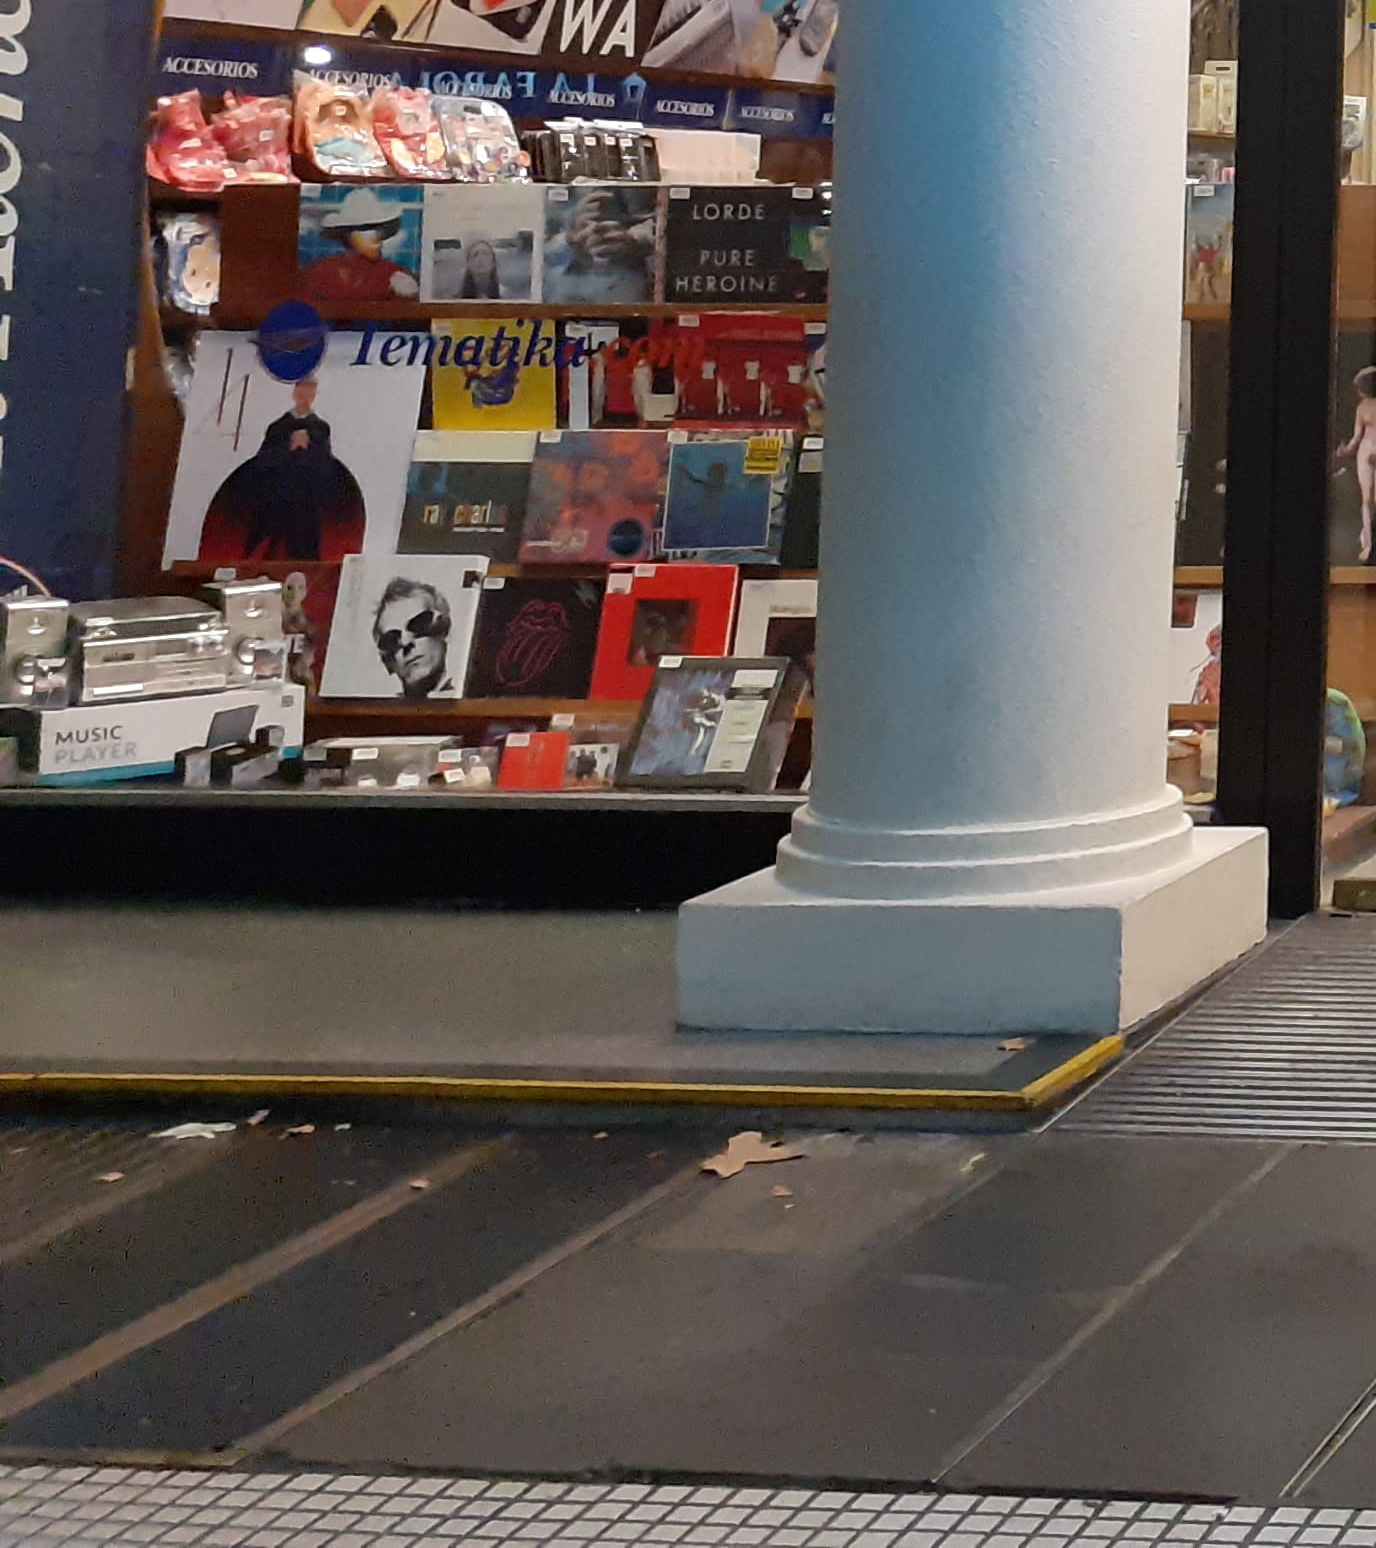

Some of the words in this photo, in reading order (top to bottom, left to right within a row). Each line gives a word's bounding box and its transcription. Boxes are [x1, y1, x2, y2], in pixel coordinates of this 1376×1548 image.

[162, 56, 258, 79] ACCESORIOS
[309, 68, 392, 89] ACCESORIOS
[656, 100, 715, 117] ACCESORIOS
[692, 203, 766, 220] LORDE
[700, 250, 755, 266] PURE
[675, 275, 778, 293] HEROINE
[54, 724, 123, 745] MUSIC
[54, 741, 137, 764] PLAYER
